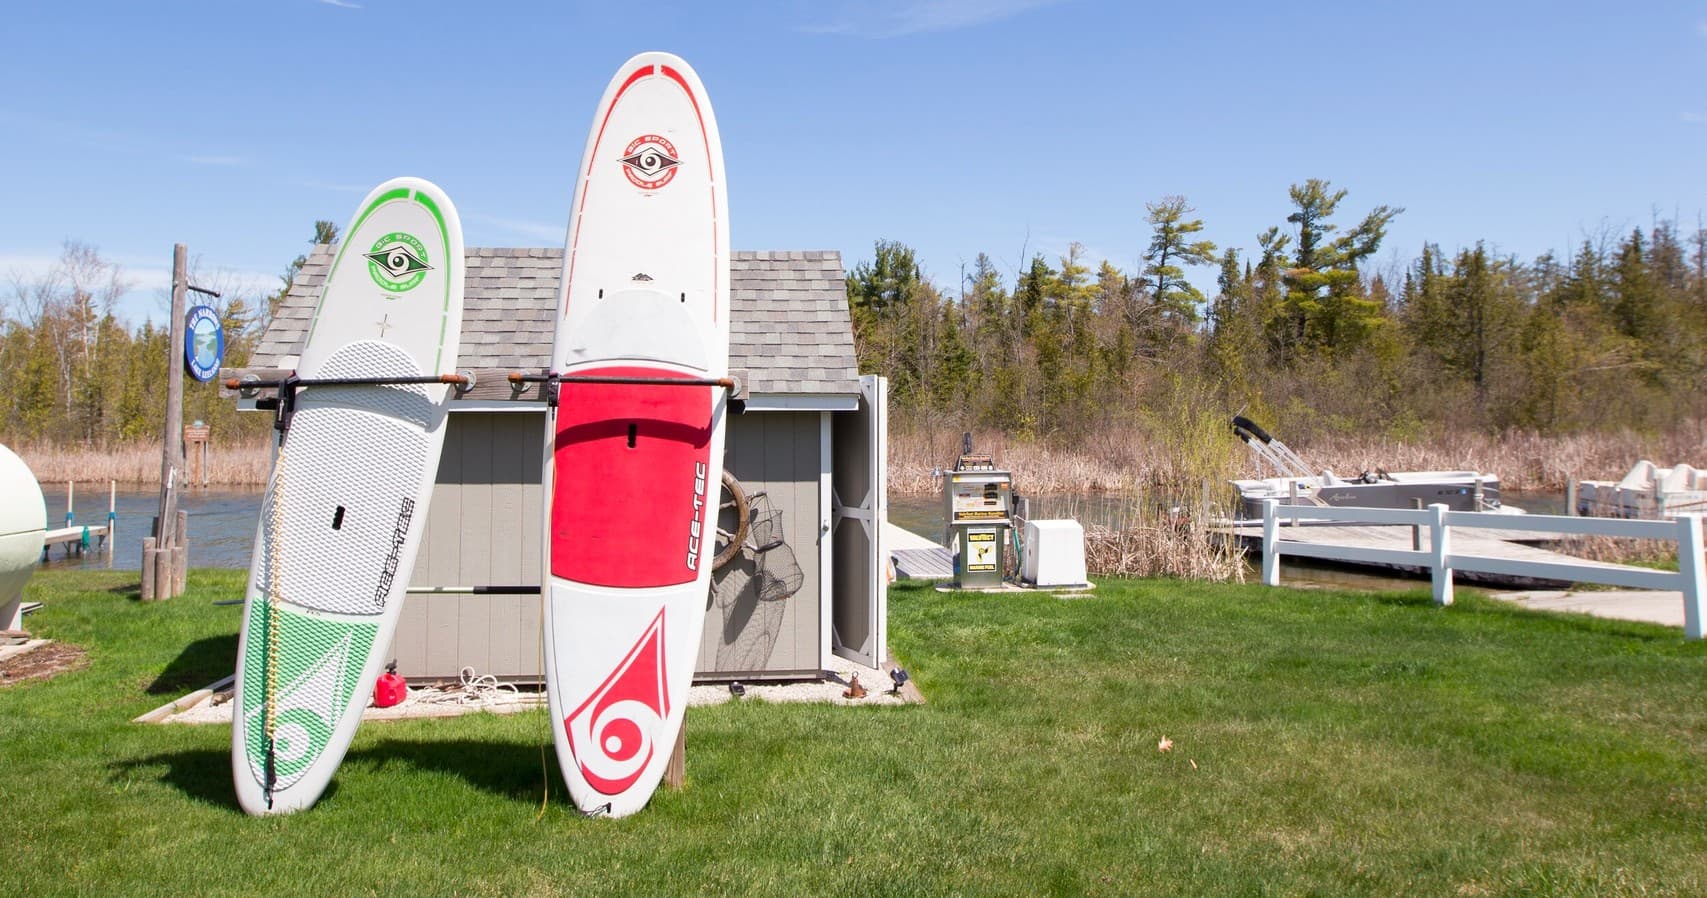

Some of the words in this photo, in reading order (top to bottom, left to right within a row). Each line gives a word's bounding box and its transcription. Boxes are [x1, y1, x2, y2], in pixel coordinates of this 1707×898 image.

[627, 138, 642, 153] BIC
[644, 135, 676, 156] SPORT
[375, 237, 391, 249] BIC
[395, 234, 426, 259] SPORT
[686, 461, 706, 571] ACE-TEC
